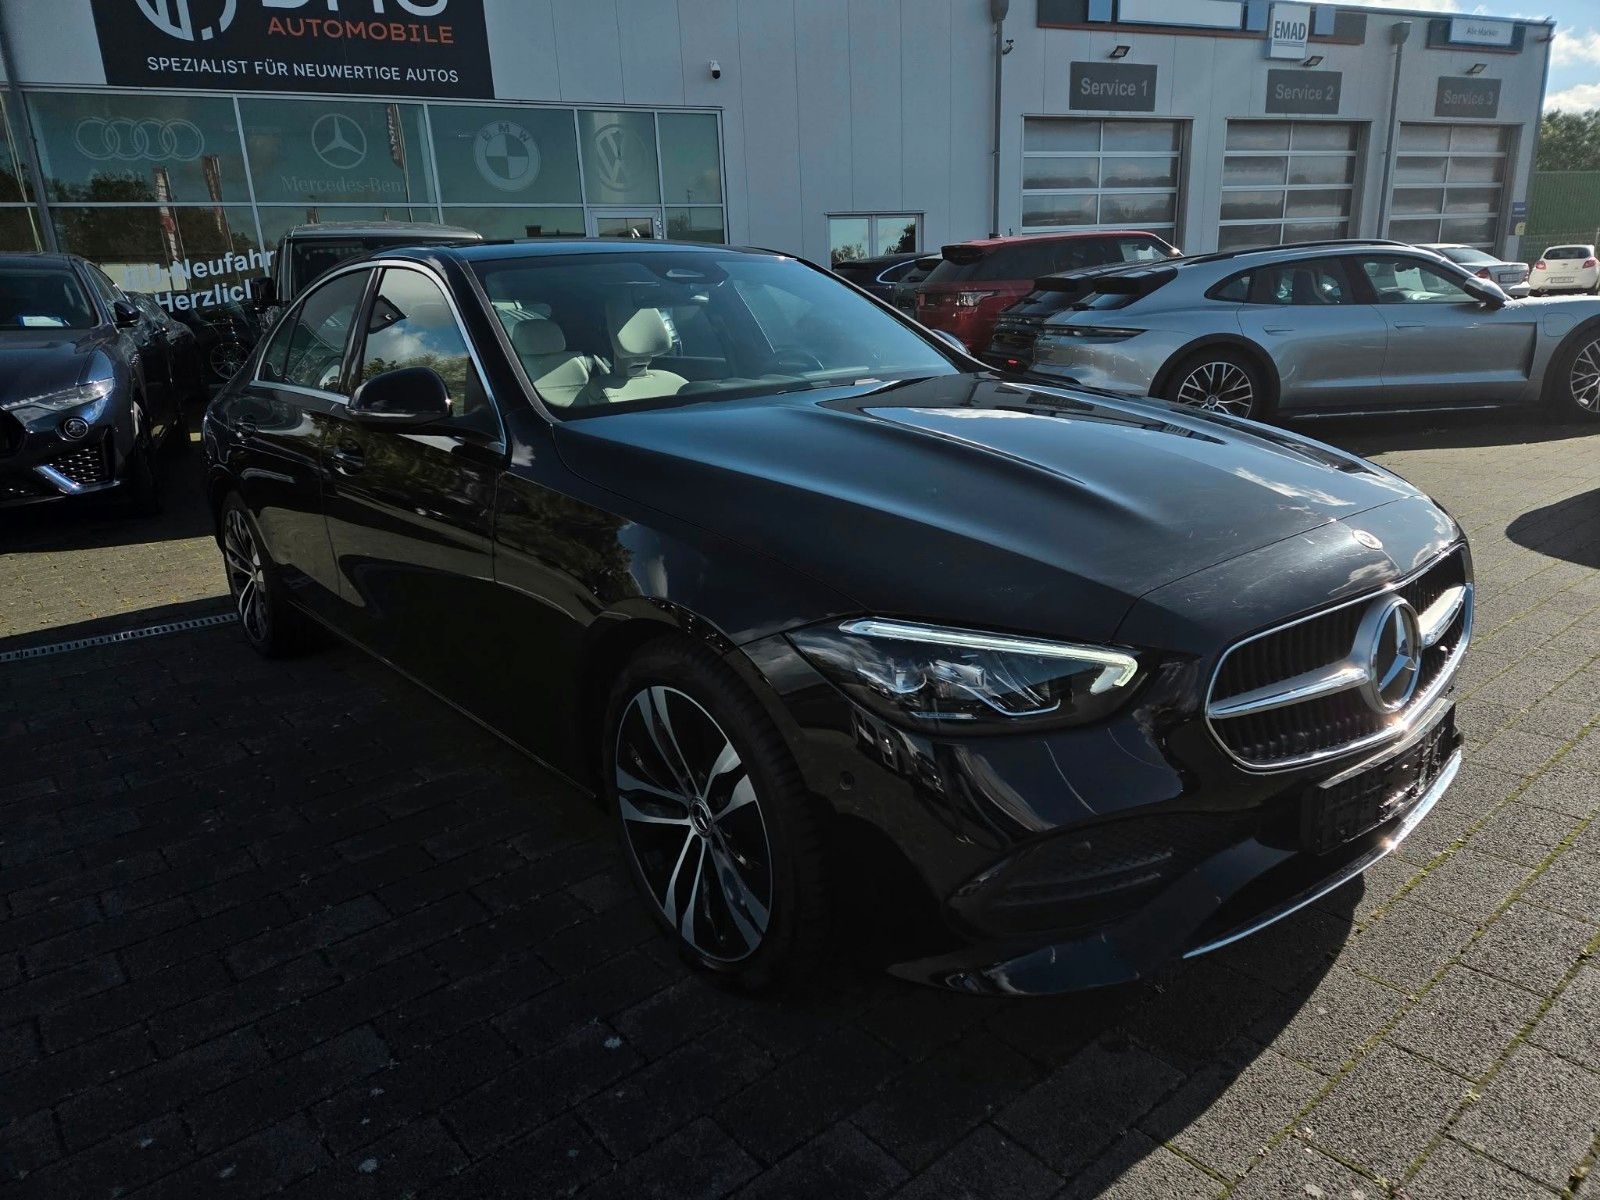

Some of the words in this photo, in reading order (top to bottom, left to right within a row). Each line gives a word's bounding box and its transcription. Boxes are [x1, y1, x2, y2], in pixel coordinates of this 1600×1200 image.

[267, 16, 454, 44] AUTOMOBILE
[1274, 20, 1306, 40] EMAD
[146, 56, 249, 75] SPEZIALIST
[254, 57, 288, 77] FÜR
[293, 62, 400, 81] NEUWERTIGE
[405, 67, 459, 83] AUTOS
[1080, 77, 1136, 97] Service
[1140, 80, 1149, 97] 1
[1275, 83, 1322, 101] Service
[1325, 85, 1334, 101] 2
[1443, 89, 1482, 105] Service
[1486, 90, 1495, 106] 3
[280, 175, 405, 194] Mercedes-Ben
